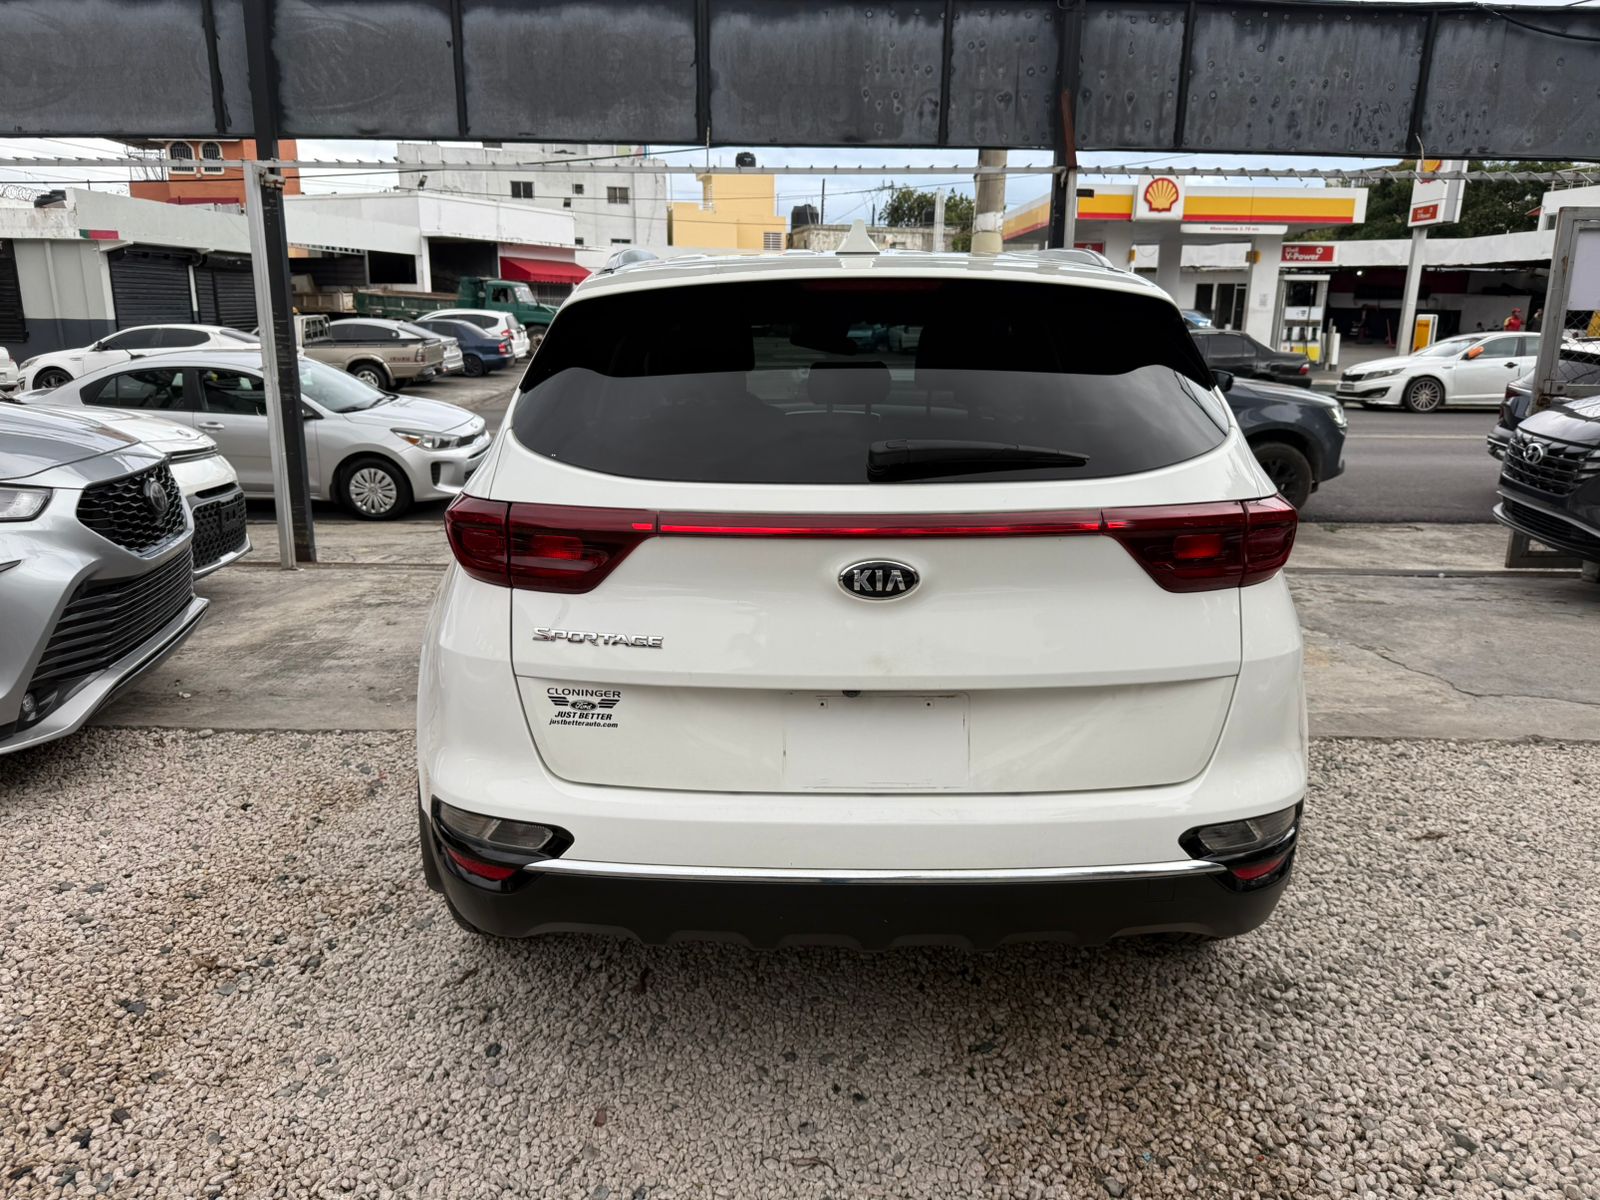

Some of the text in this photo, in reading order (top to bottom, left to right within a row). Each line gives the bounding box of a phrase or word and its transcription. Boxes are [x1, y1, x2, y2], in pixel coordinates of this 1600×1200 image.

[1285, 252, 1320, 260] V-Power
[853, 569, 906, 591] KIA
[532, 627, 664, 649] SPORTAGE
[547, 687, 622, 698] CLONINGER
[555, 711, 612, 721] JUST BETTER
[549, 718, 618, 728] justbetterauto.com
